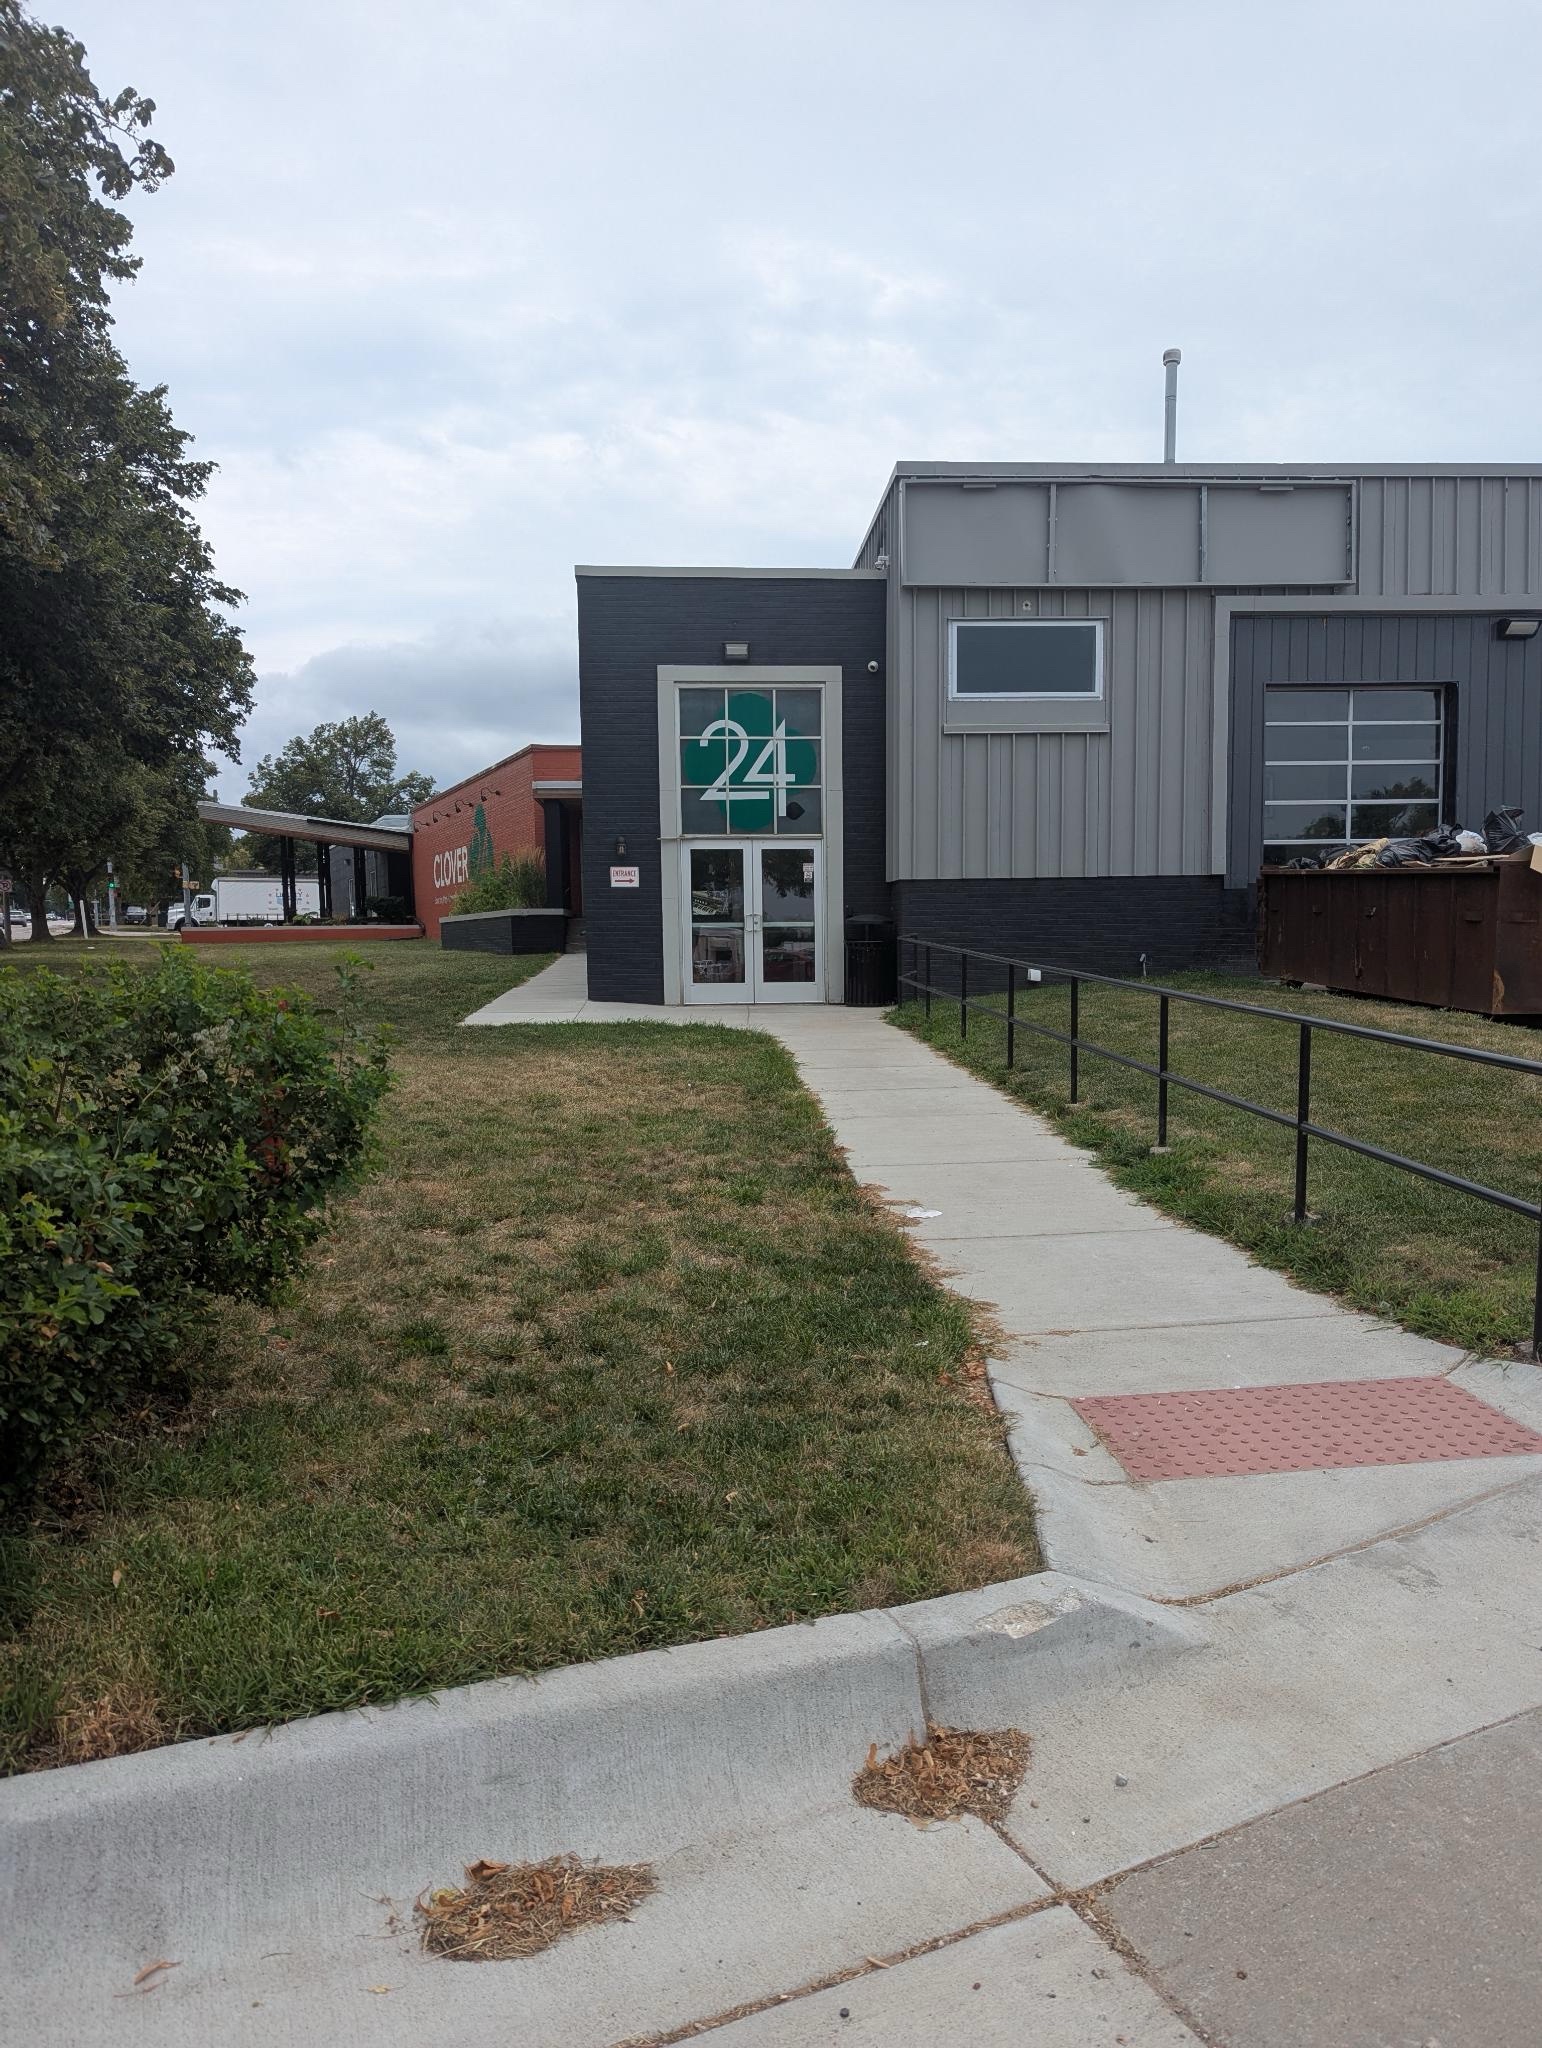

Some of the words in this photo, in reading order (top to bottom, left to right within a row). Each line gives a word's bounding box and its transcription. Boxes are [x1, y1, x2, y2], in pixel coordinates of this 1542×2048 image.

[700, 718, 796, 817] 24
[433, 845, 469, 889] CLOVER
[612, 869, 637, 878] ENTRANCE
